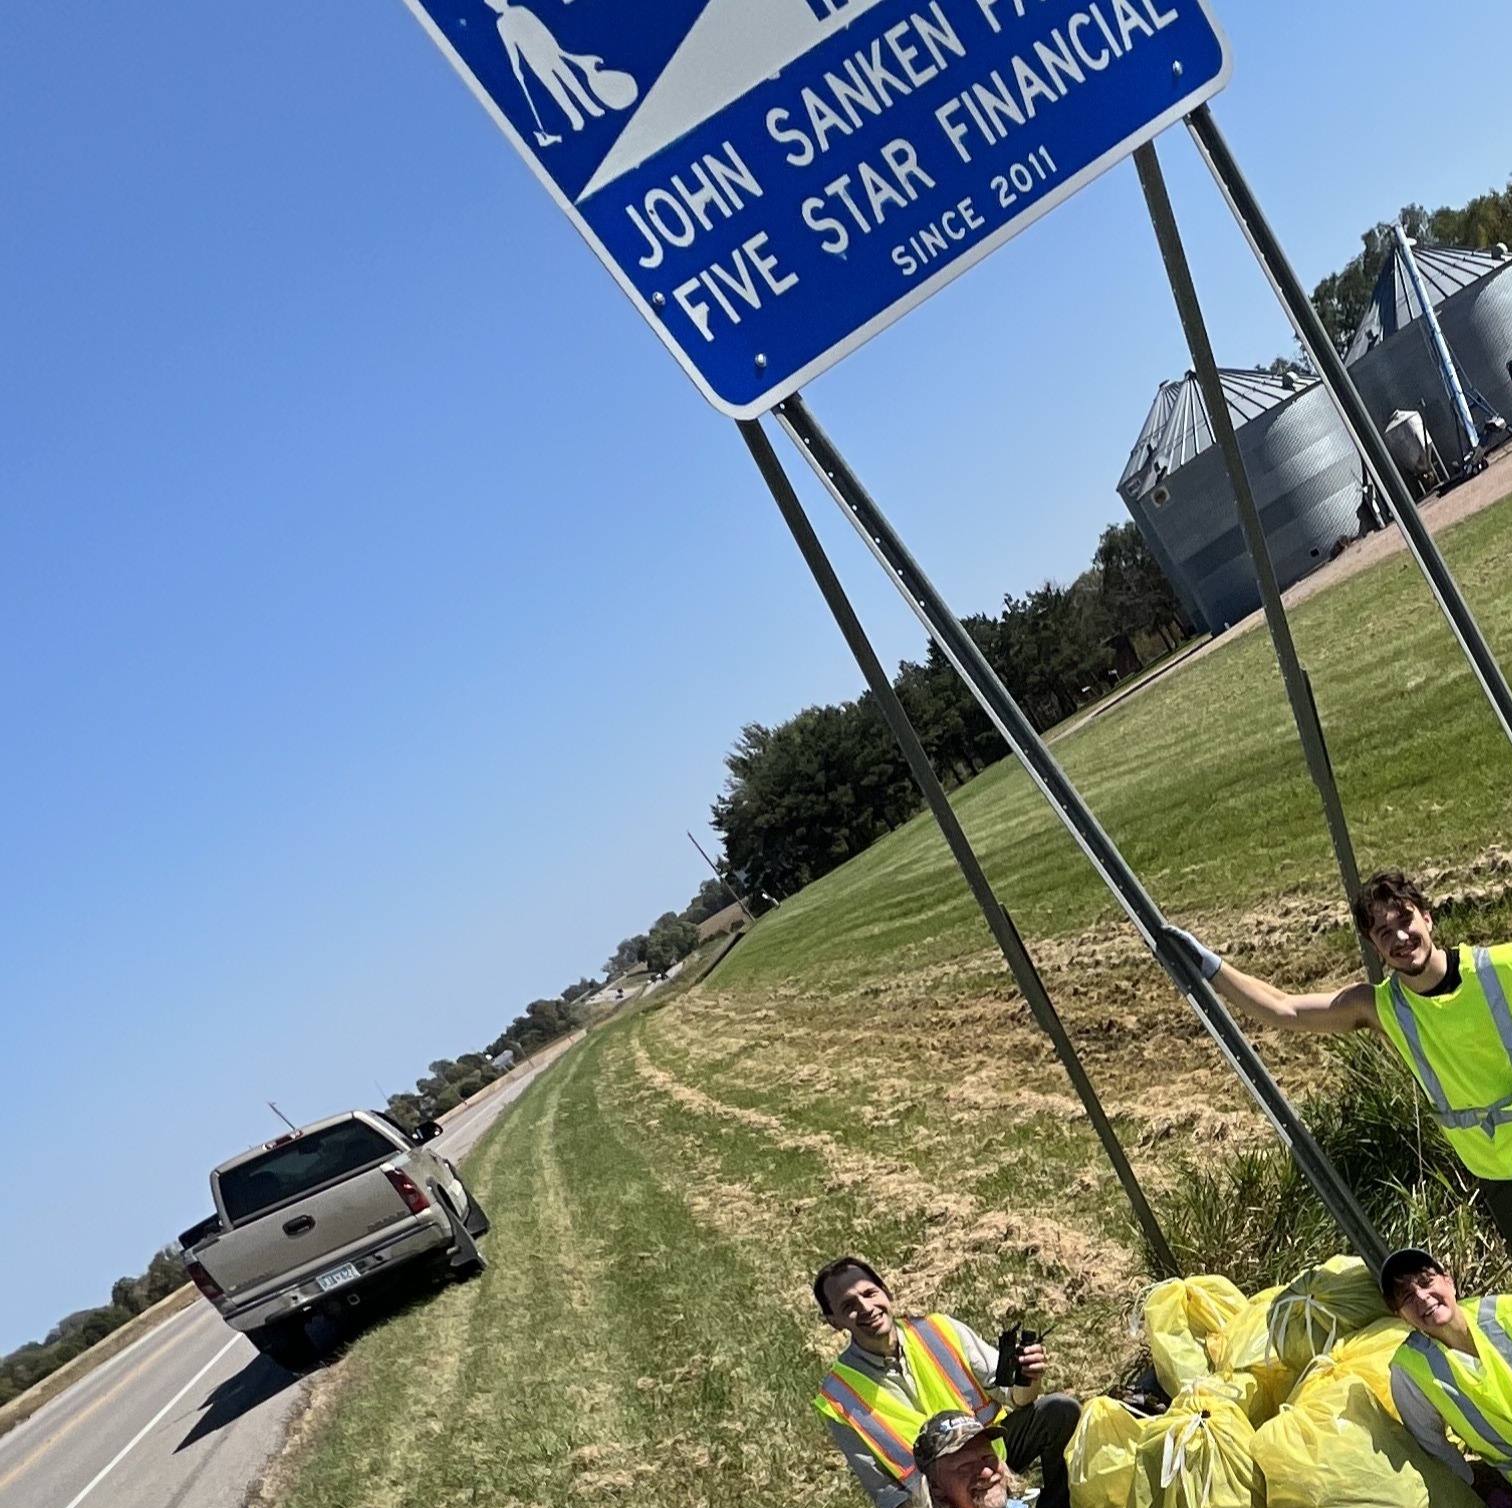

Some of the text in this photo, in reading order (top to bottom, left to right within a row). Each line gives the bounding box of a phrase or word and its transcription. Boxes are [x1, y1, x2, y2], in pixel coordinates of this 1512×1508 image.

[625, 0, 967, 269] JOHN SANKEN
[672, 0, 1179, 342] FIVE STAR FINANCIAL
[891, 144, 1058, 276] SINCE 2011
